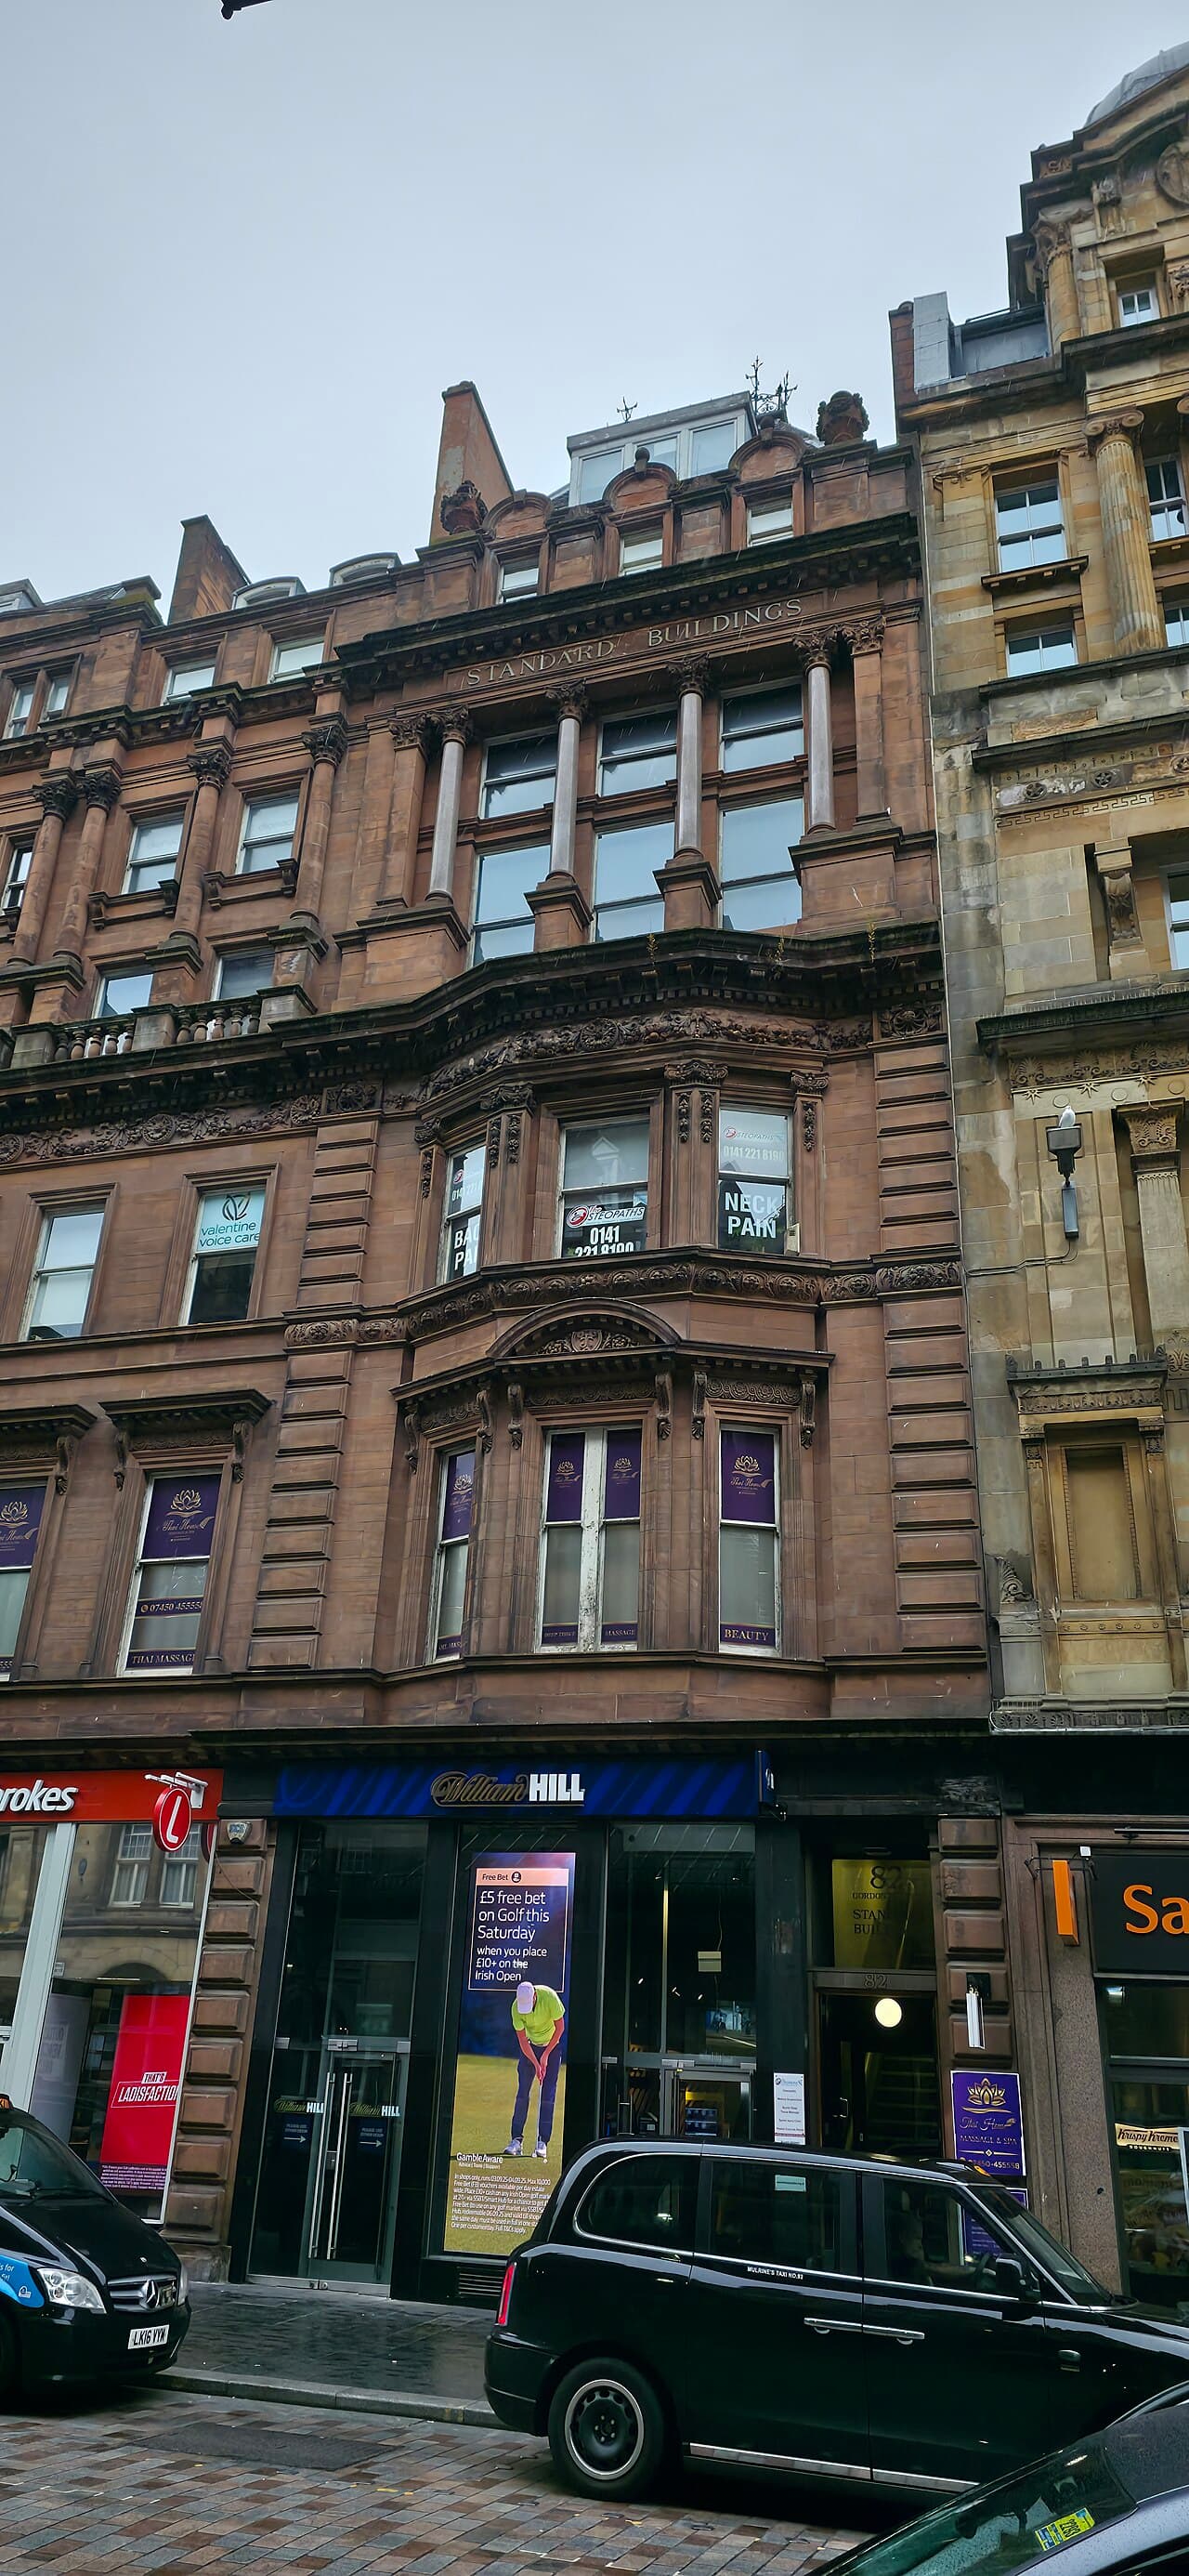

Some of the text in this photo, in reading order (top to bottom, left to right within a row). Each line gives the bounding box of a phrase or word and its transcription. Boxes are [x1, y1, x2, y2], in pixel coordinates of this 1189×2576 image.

[466, 598, 803, 687] STANDARD BUILDINGS
[725, 1191, 777, 1215] NECK
[201, 1221, 257, 1236] valentine
[727, 1216, 777, 1239] PAIN
[200, 1234, 232, 1247] voice
[590, 1226, 620, 1245] 0141
[150, 1602, 175, 1612] 07450
[725, 1628, 769, 1641] BEAUTY
[132, 1655, 154, 1664] THAI
[431, 1770, 585, 1804] William HILL
[869, 1865, 902, 1889] 82
[479, 1890, 546, 1905] £5 free bet
[478, 1908, 550, 1922] on Golf this
[477, 1925, 536, 1943] Saturday
[477, 1945, 547, 1958] when you place
[476, 1957, 529, 1969] £10+ on the
[475, 1970, 522, 1983] Irish Open
[863, 1973, 888, 1990] 82
[307, 2101, 324, 2114] HILL
[381, 2105, 400, 2117] HILL
[960, 2135, 994, 2144] MASSAGE
[1117, 2128, 1147, 2143] Krispy
[456, 2152, 503, 2163] GambleAware
[5, 2263, 15, 2272] for
[747, 2266, 775, 2276] MULRINE'S
[134, 2331, 151, 2346] LK16
